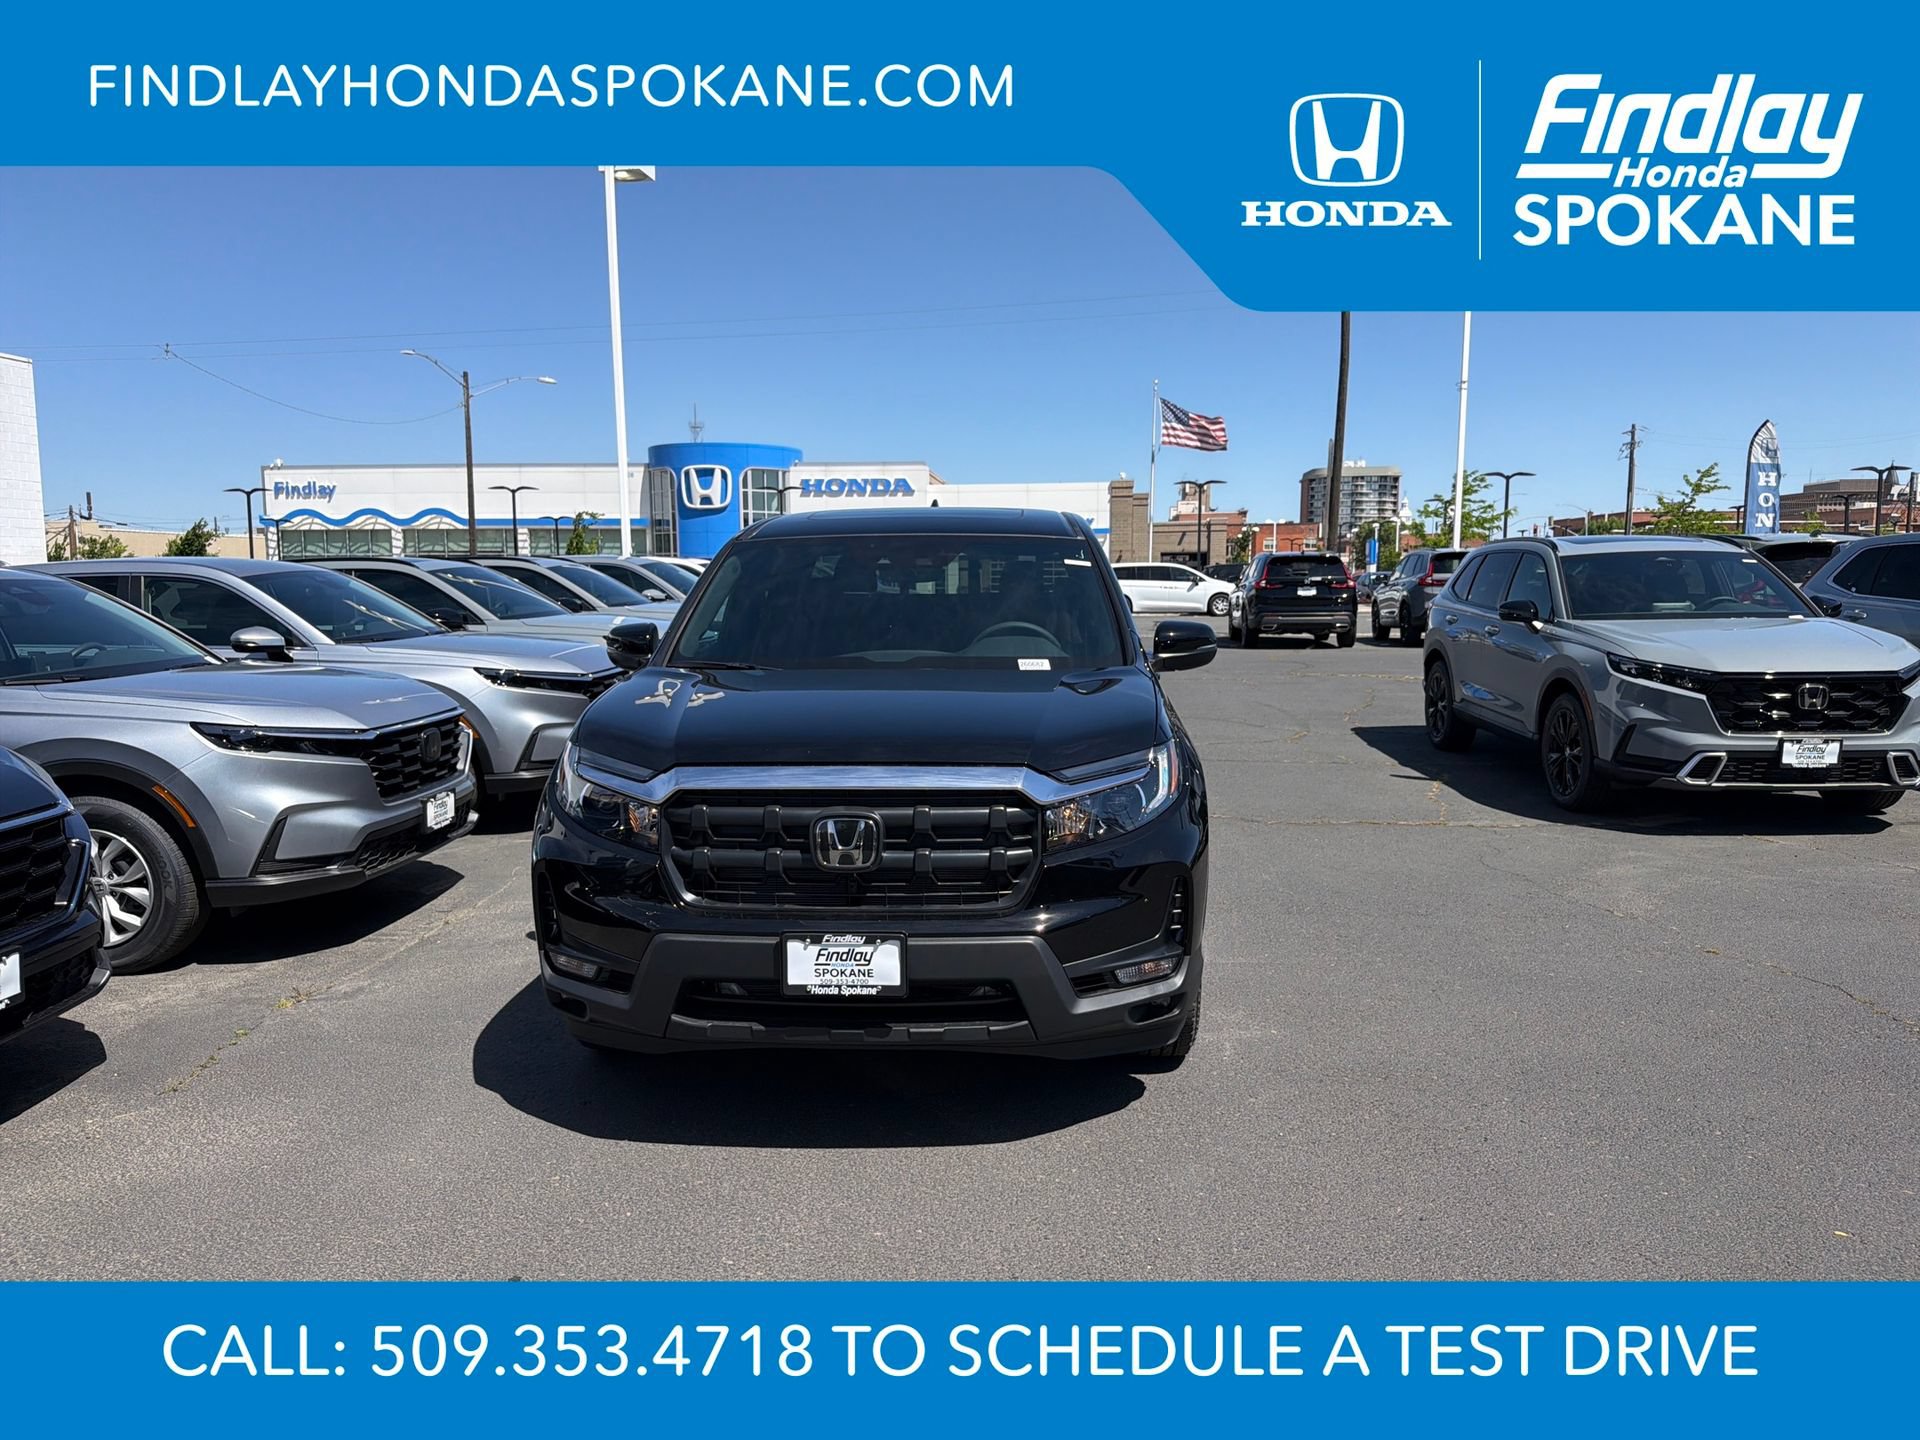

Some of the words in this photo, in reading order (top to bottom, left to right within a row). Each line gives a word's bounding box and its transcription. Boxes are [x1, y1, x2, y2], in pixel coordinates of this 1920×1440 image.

[273, 481, 336, 503] Findlay
[800, 478, 915, 498] HONDA
[821, 934, 866, 945] Findlay
[815, 948, 874, 966] Findlay
[814, 968, 875, 978] SPOKANE
[810, 985, 839, 995] Honda
[840, 985, 878, 997] Spokane
